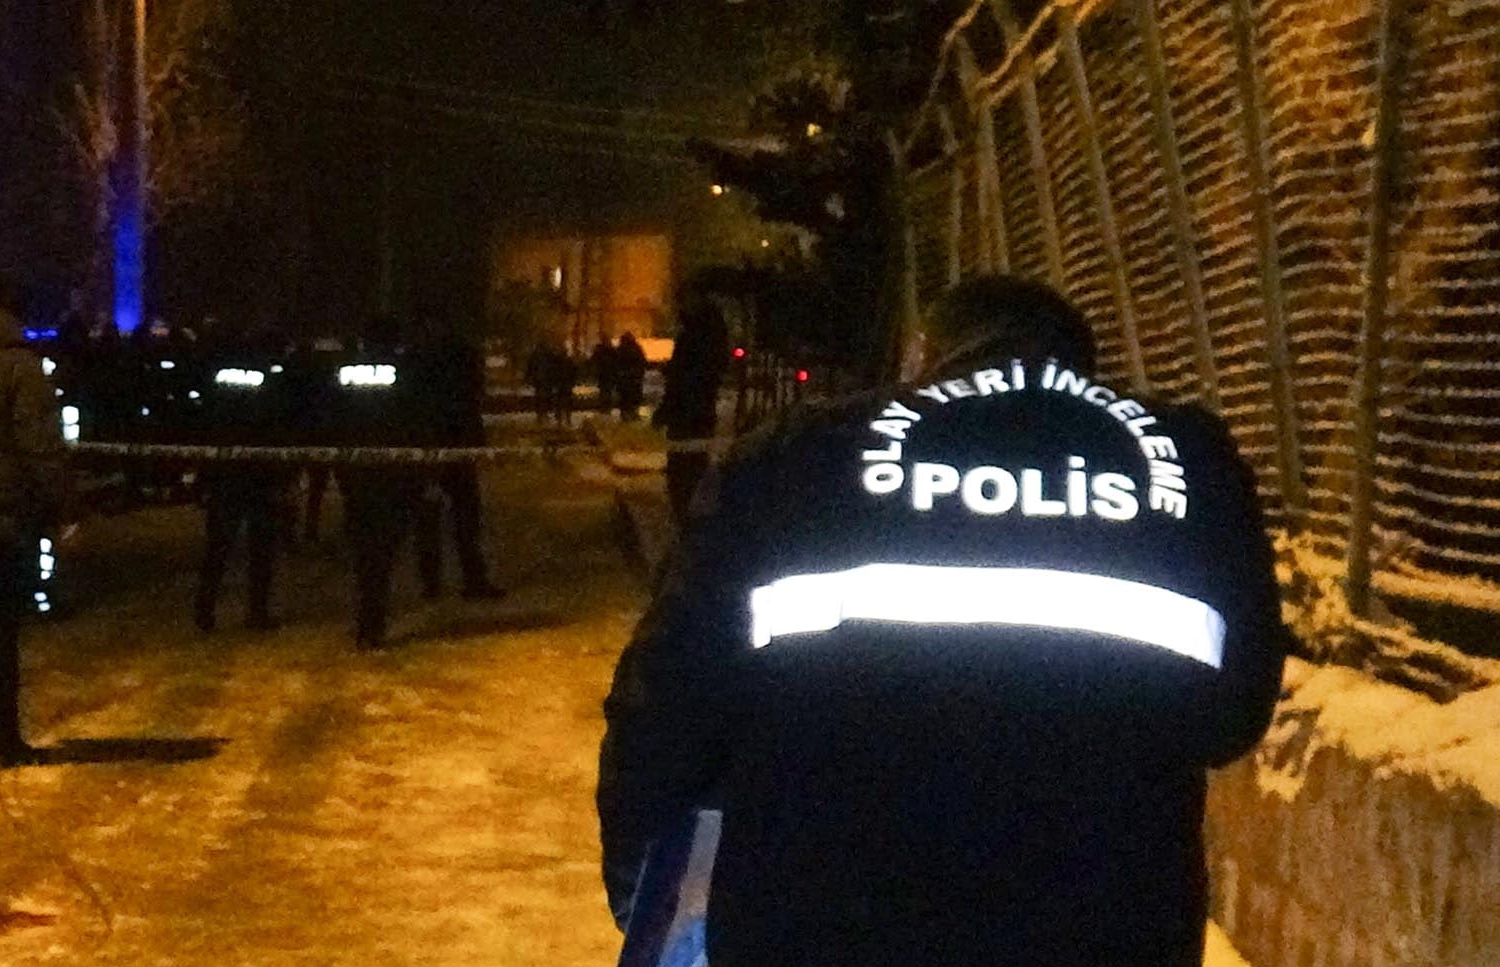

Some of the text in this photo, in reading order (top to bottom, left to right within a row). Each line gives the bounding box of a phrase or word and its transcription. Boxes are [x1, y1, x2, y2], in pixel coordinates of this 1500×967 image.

[862, 358, 1188, 519] OLAY YERİ İNCELEME
[912, 456, 1139, 521] POLİS
